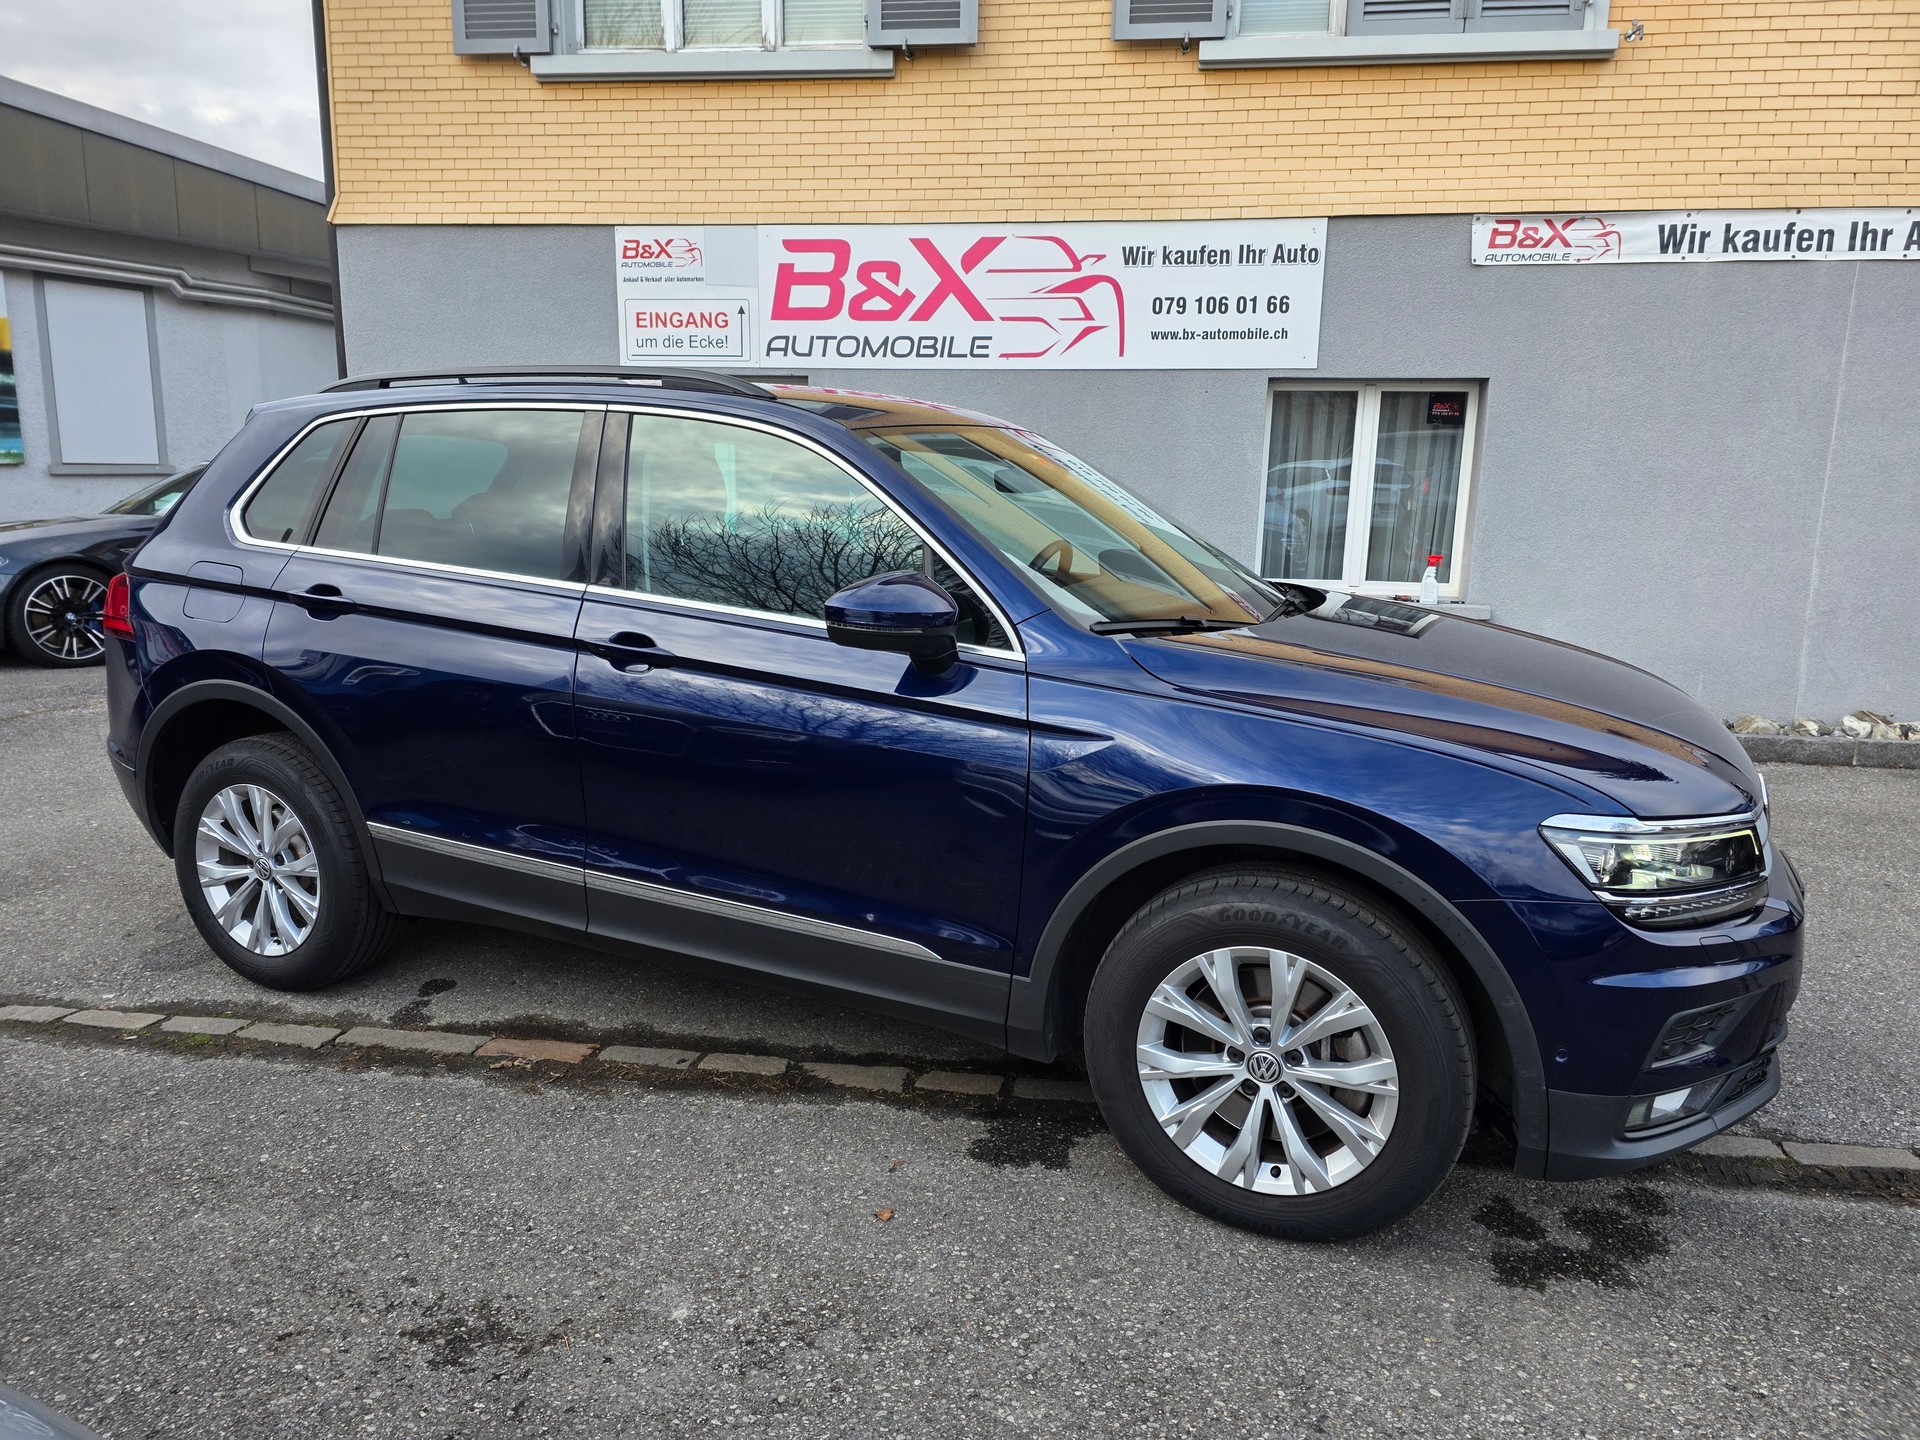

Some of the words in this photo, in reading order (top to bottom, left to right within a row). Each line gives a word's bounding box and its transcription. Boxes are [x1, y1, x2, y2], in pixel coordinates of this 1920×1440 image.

[1488, 218, 1580, 249] B&X
[1658, 223, 1711, 254] Wir
[1721, 222, 1835, 254] kaufen
[1847, 221, 1894, 252] Ihr
[622, 238, 675, 259] B&X
[1121, 245, 1156, 266] Wir
[1161, 244, 1231, 266] kaufen
[1238, 243, 1267, 265] Ihr
[1271, 243, 1320, 264] Auto
[1484, 252, 1572, 262] AUTOMOBILE
[771, 237, 1007, 322] B&X
[1152, 296, 1187, 315] 079
[1195, 296, 1229, 315] 106
[1236, 295, 1258, 314] 01
[1266, 295, 1290, 314] 66
[635, 311, 729, 329] EINGANG
[636, 336, 658, 349] um
[662, 334, 684, 349] die
[689, 334, 728, 349] Ecke!
[1150, 327, 1288, 341] www.bx-automobile.ch
[766, 335, 993, 358] AUTOMOBILE
